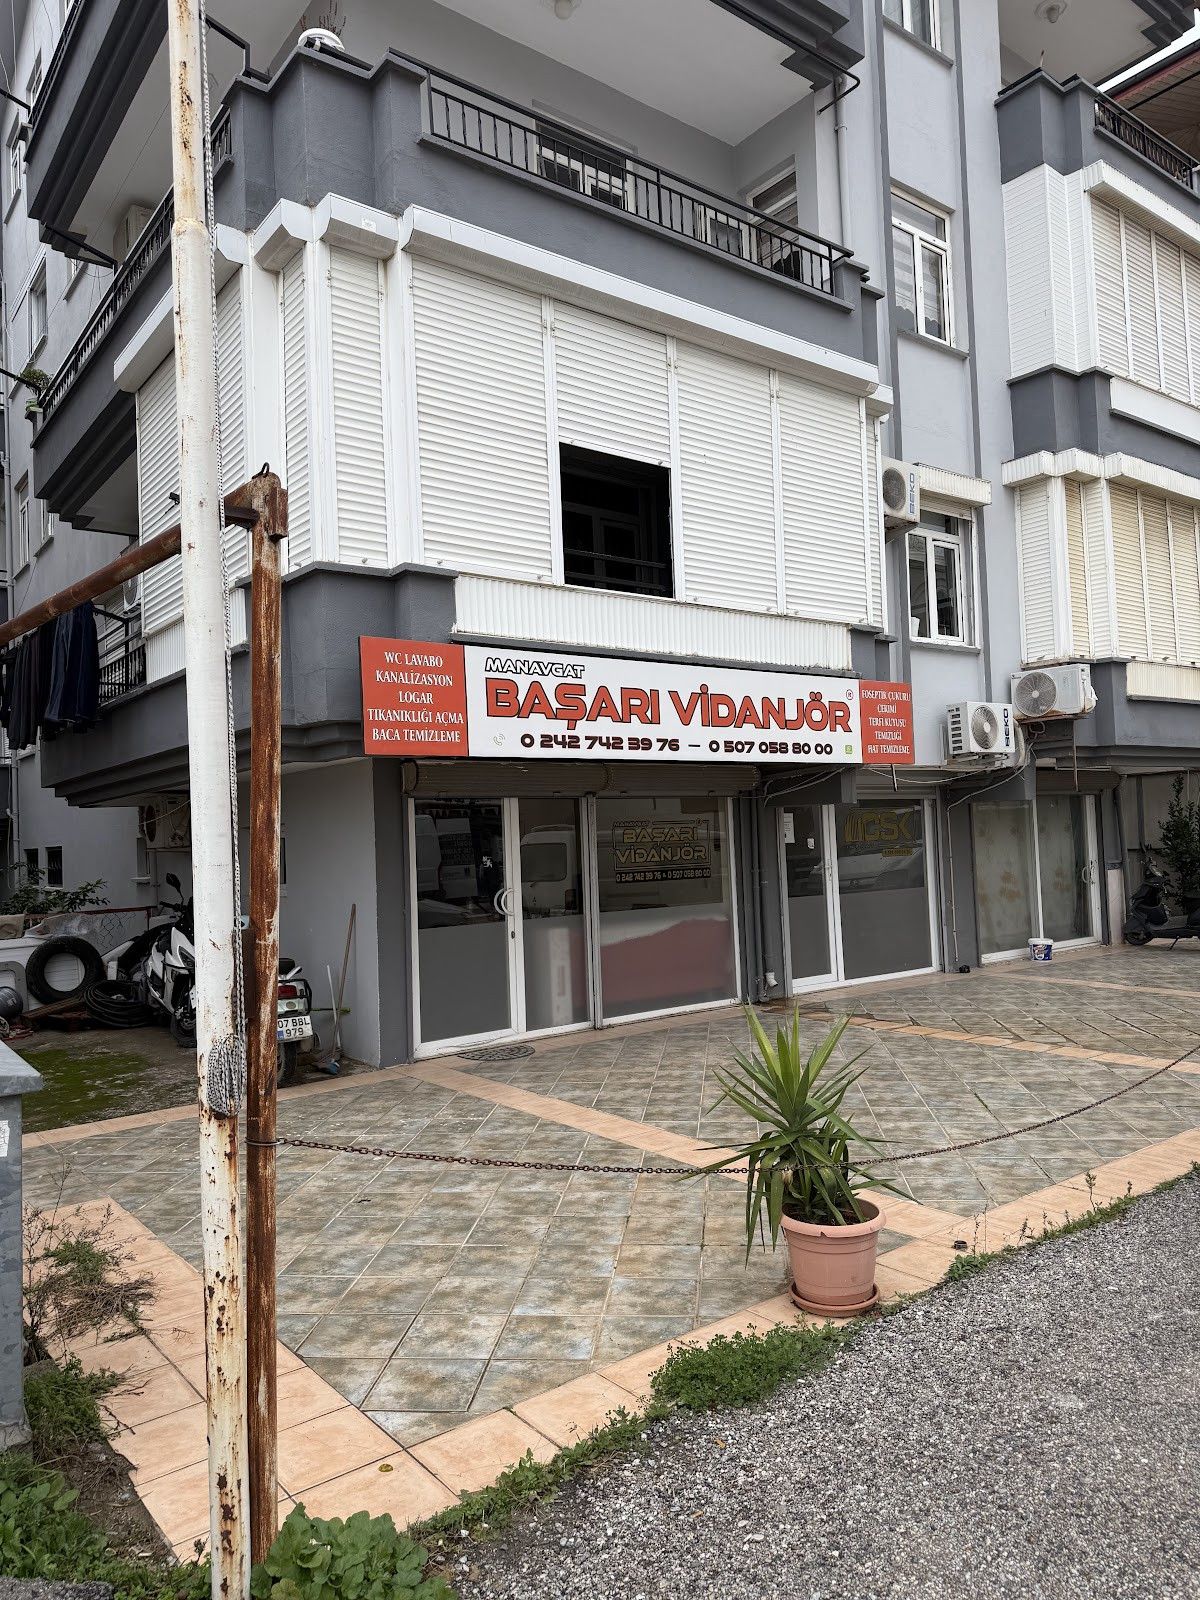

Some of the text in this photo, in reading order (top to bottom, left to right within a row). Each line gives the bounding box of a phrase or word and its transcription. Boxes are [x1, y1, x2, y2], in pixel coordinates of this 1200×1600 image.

[384, 652, 443, 667] WC LAVABO
[485, 657, 585, 679] MANAVGAT
[375, 670, 453, 686] KANALİZASYON
[398, 691, 434, 704] LOGAR
[485, 677, 853, 733] BAŞARI VİDANJÖR
[367, 708, 464, 727] TIKANIKLIĞI AÇMA
[372, 728, 461, 743] BACA TEMİZLEME
[1003, 708, 1011, 747] BEKO
[520, 733, 535, 748] 0
[540, 734, 580, 749] 242
[585, 734, 624, 750] 742
[628, 735, 652, 751] 39
[656, 738, 680, 751] 76
[709, 740, 720, 752] 0
[724, 740, 757, 753] 507
[759, 741, 789, 754] 058
[792, 742, 811, 755] 80
[815, 743, 833, 755] 00
[623, 826, 699, 846] BAŞARI
[615, 843, 707, 864] VİDANJÖR
[278, 1017, 310, 1028] 07 BBL
[286, 1027, 303, 1037] 979
